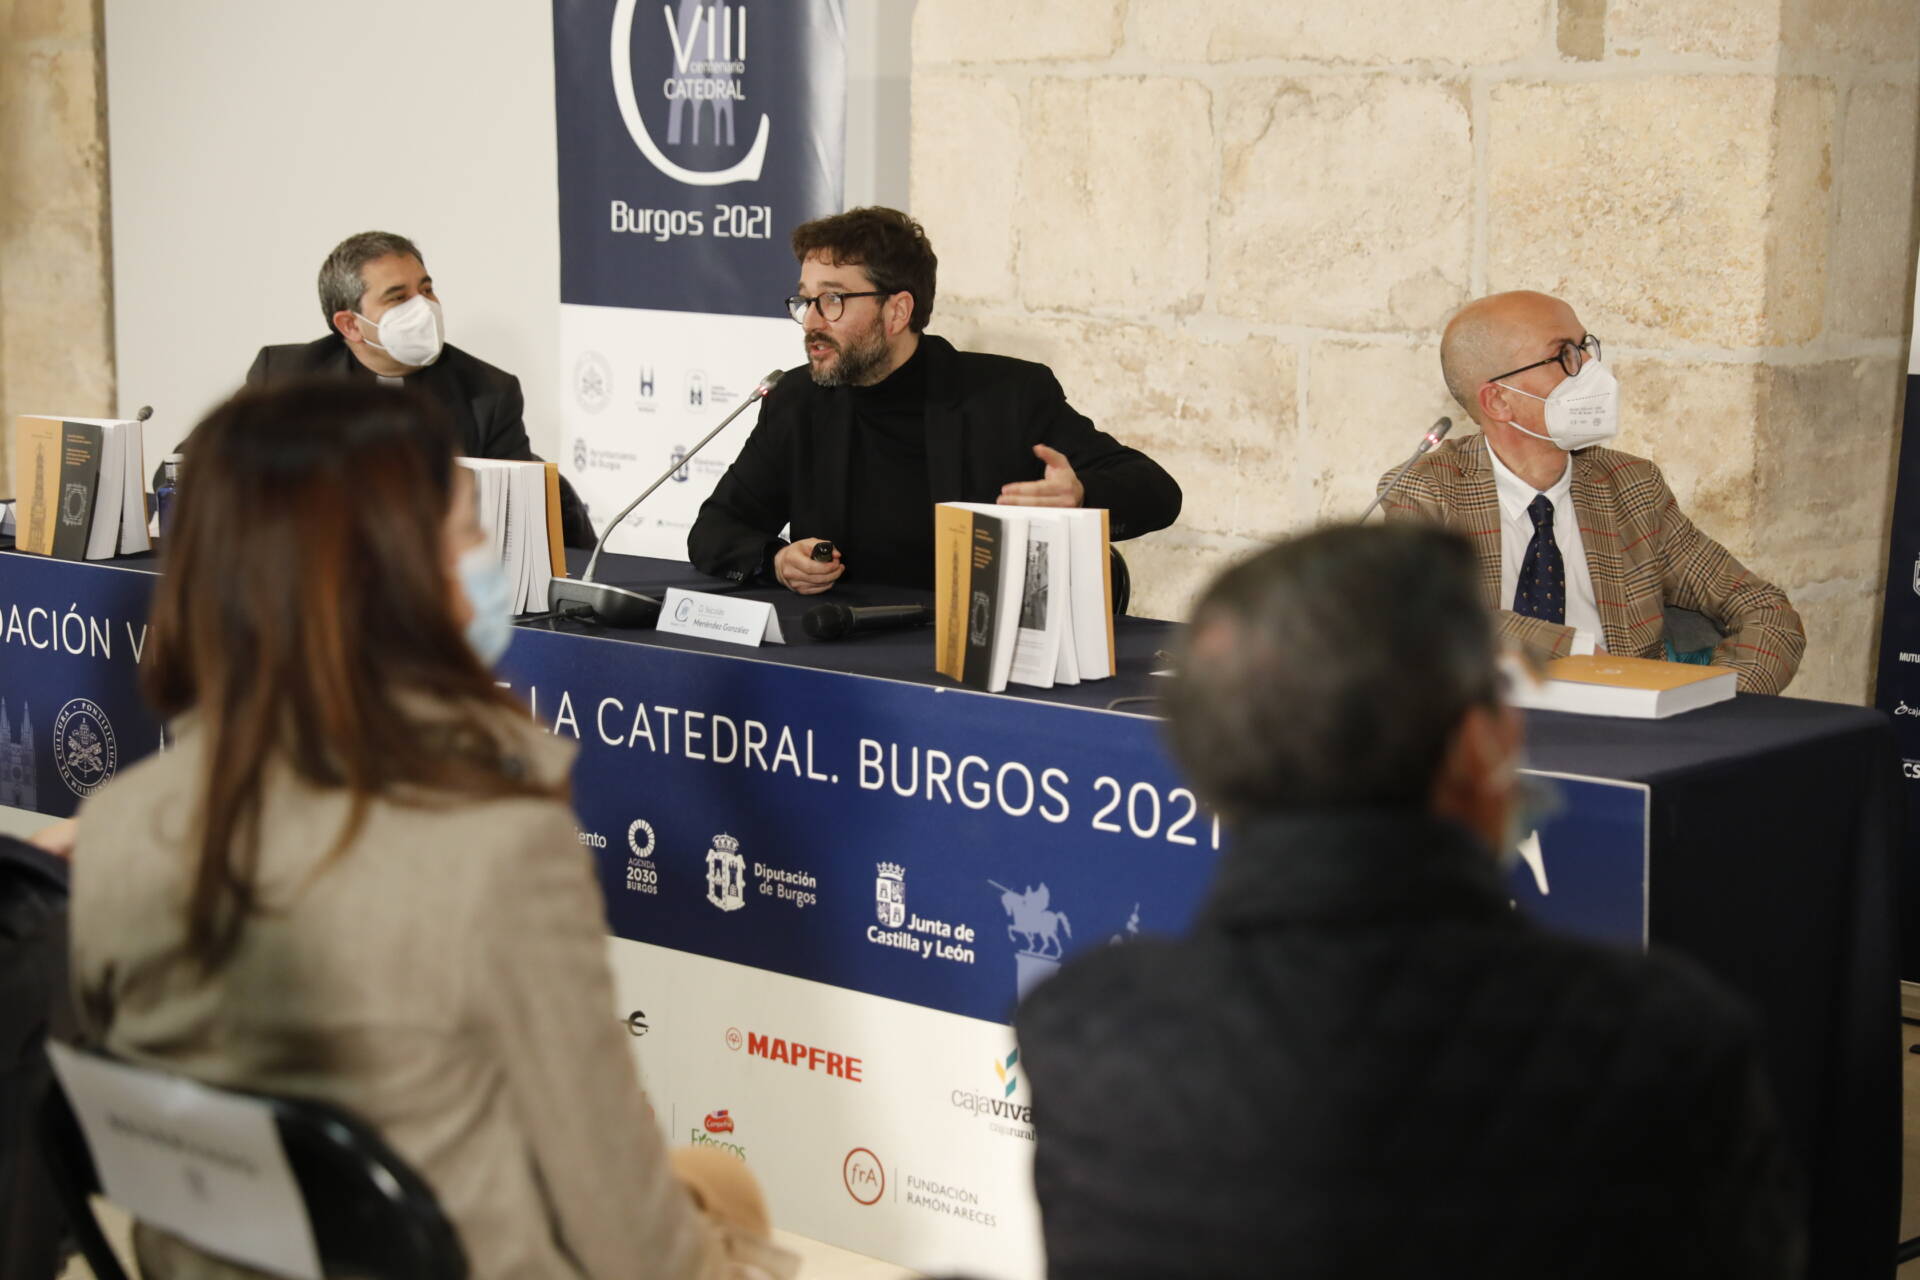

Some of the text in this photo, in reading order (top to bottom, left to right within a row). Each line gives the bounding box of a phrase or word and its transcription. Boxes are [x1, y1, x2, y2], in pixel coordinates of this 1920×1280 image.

[664, 4, 746, 74] VIII
[664, 78, 746, 100] CATEDRAL
[611, 200, 771, 242] Burgos 2021
[0, 602, 110, 660] ACIÓN
[597, 698, 838, 784] CATEDRAL.
[859, 738, 1070, 823] BURGOS
[1092, 776, 1220, 850] 2021
[626, 866, 658, 884] 2030
[628, 858, 656, 870] AGENDA
[754, 863, 817, 889] Diputación
[626, 880, 658, 895] BURGOS
[759, 881, 817, 908] de Burgos
[907, 913, 975, 943] Junta de
[866, 925, 975, 964] Castilla y León
[748, 1032, 863, 1083] MAPFRE
[691, 1128, 746, 1160] Fros
[851, 1163, 878, 1187] frA
[906, 1175, 978, 1204] FUNDACIÓN
[906, 1191, 997, 1227] RAMÓN ARECES
